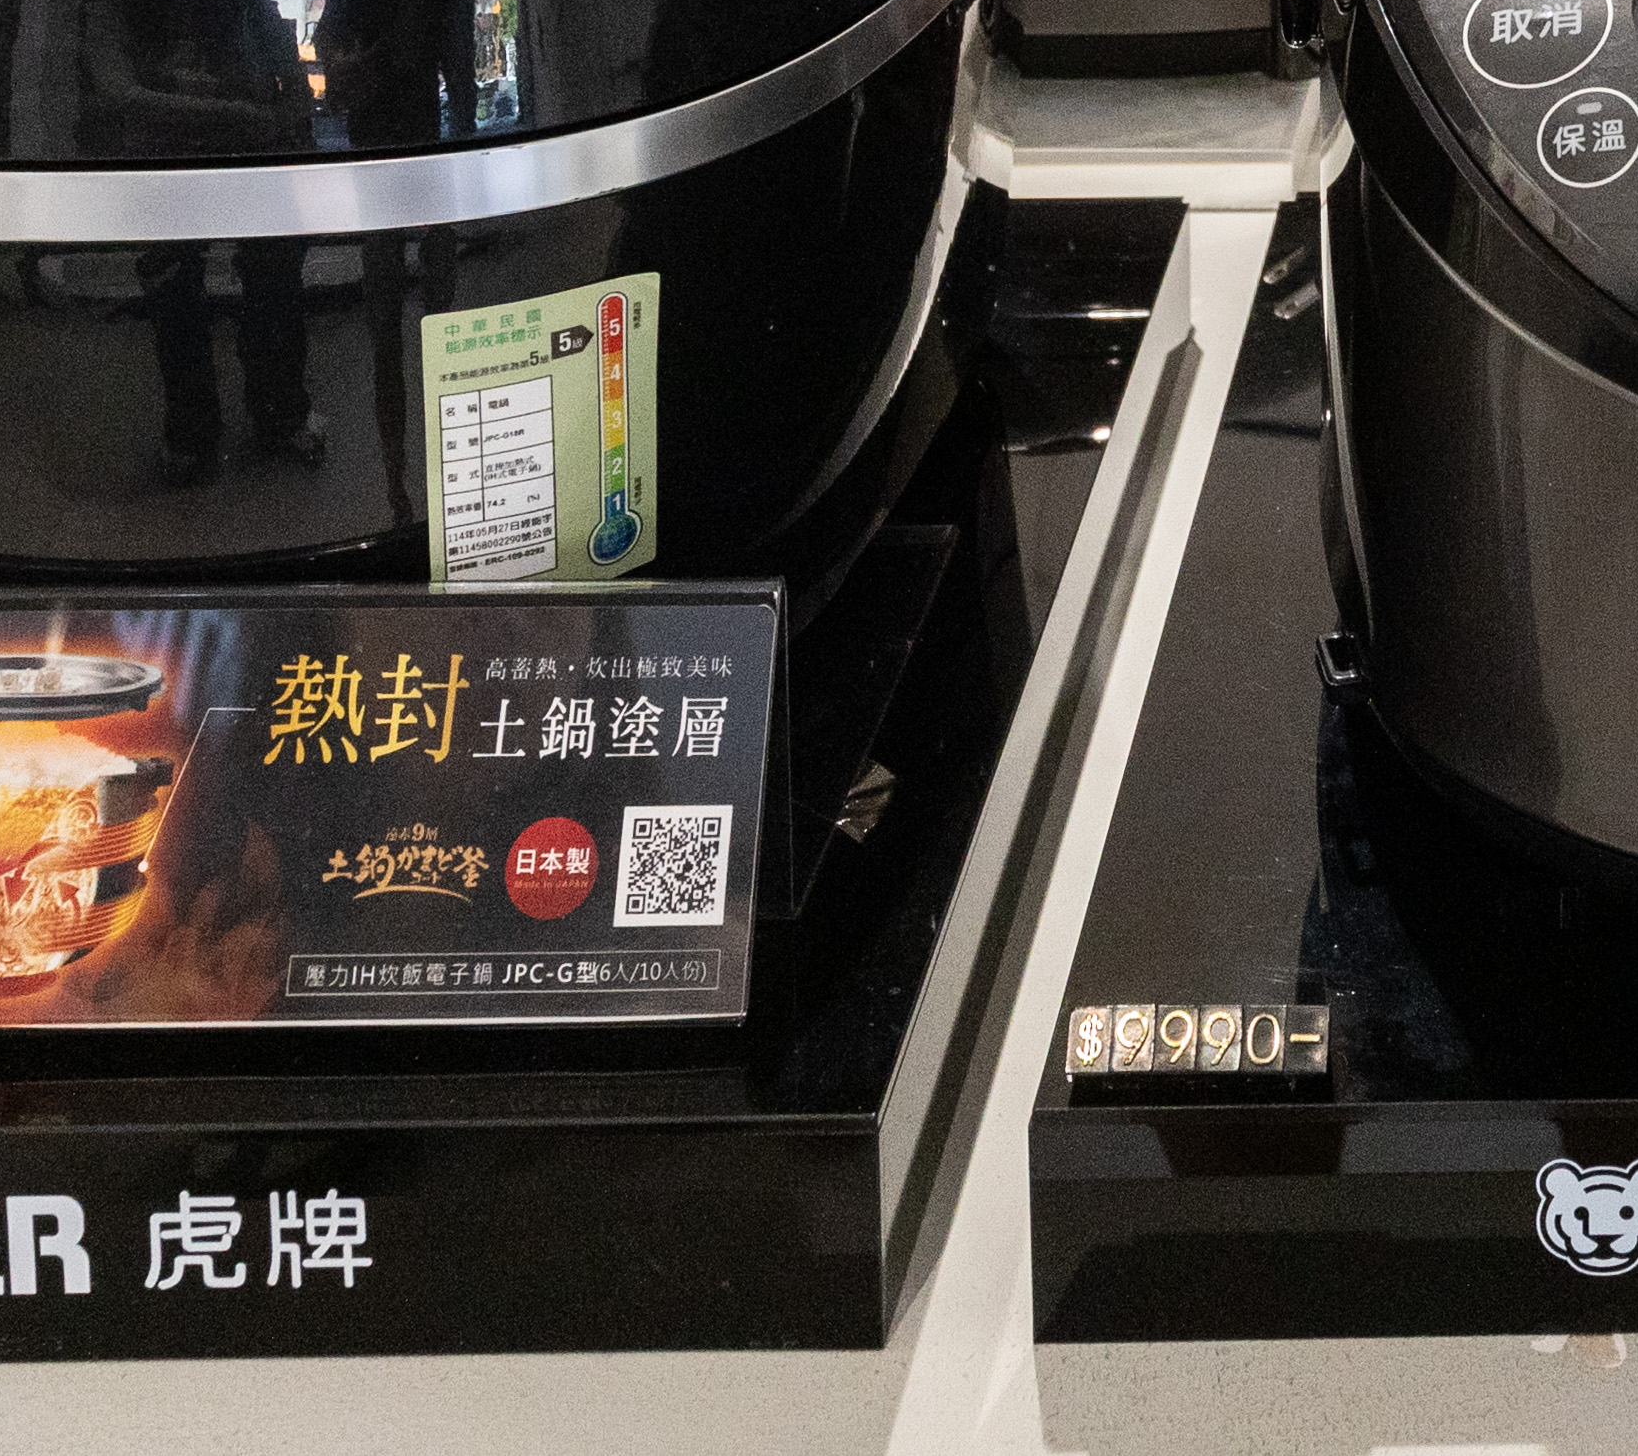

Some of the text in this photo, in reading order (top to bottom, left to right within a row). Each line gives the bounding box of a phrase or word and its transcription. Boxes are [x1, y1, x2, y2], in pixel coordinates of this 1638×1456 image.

[1490, 2, 1582, 46] 取消
[1552, 117, 1624, 155] 保溫
[609, 318, 621, 336] 5
[610, 364, 621, 380] 4
[612, 457, 623, 475] 2
[613, 494, 621, 510] 1
[516, 848, 591, 875] 日本製
[305, 962, 492, 987] 壓力IH炊飯電子鍋
[142, 1187, 373, 1292] 虎牌
